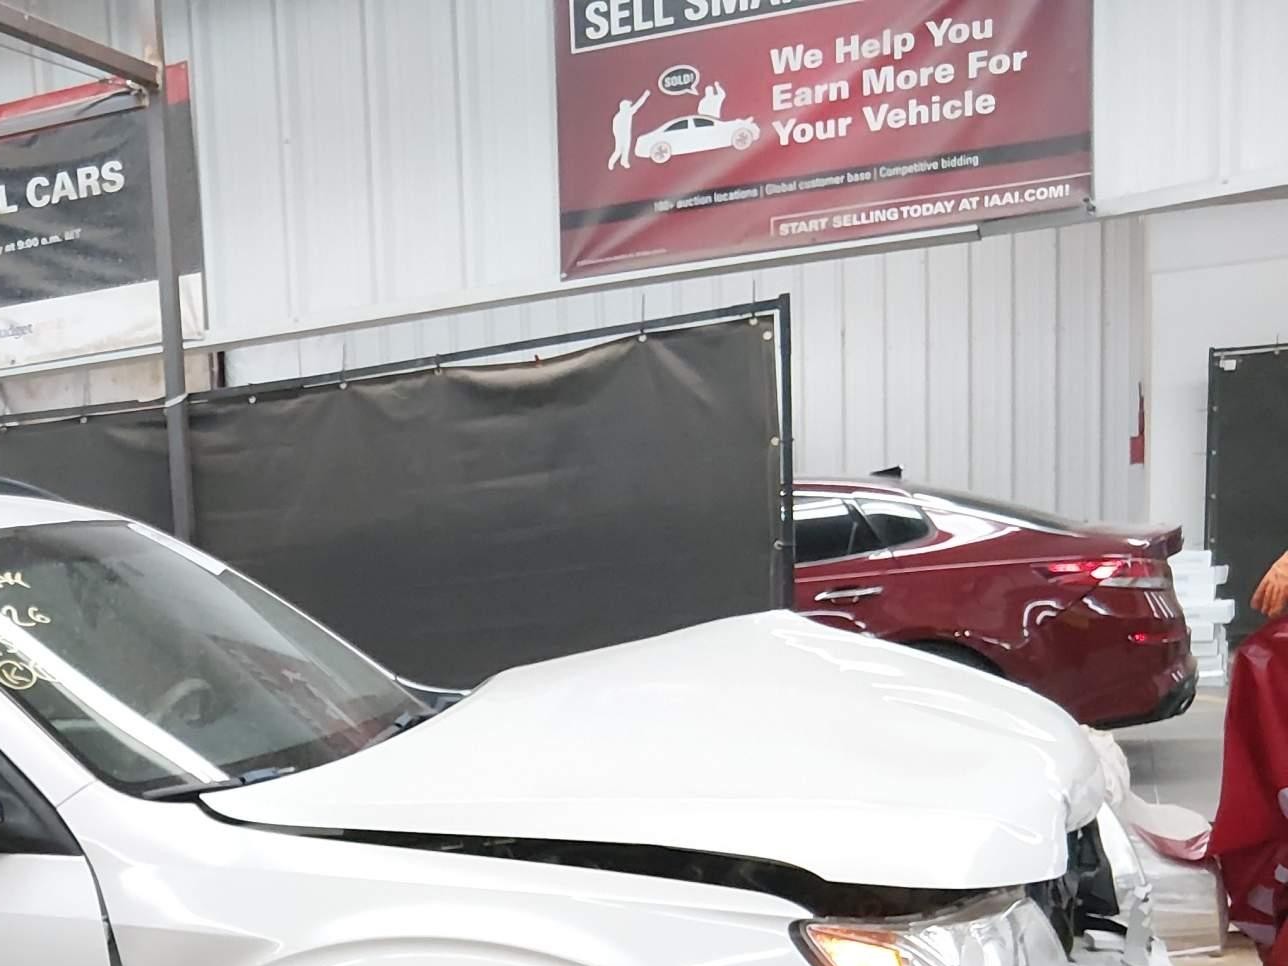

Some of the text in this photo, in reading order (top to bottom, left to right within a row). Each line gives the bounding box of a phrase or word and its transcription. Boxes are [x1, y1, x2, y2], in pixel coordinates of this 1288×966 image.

[585, 0, 674, 40] SELL
[770, 17, 995, 75] We Help You
[664, 74, 694, 88] SOLD!
[771, 48, 1028, 112] Earn More For
[772, 89, 997, 147] Your Vehicle
[25, 160, 125, 209] CARS
[676, 194, 712, 209] auction
[713, 186, 759, 203] locations
[765, 181, 797, 196] Global
[798, 175, 845, 191] customer
[847, 169, 871, 184] base
[879, 160, 939, 179] Competitive
[941, 154, 979, 170] bidding
[779, 184, 1070, 236] START SELLING TODAY AT IAAI.COM!
[4, 242, 16, 253] at
